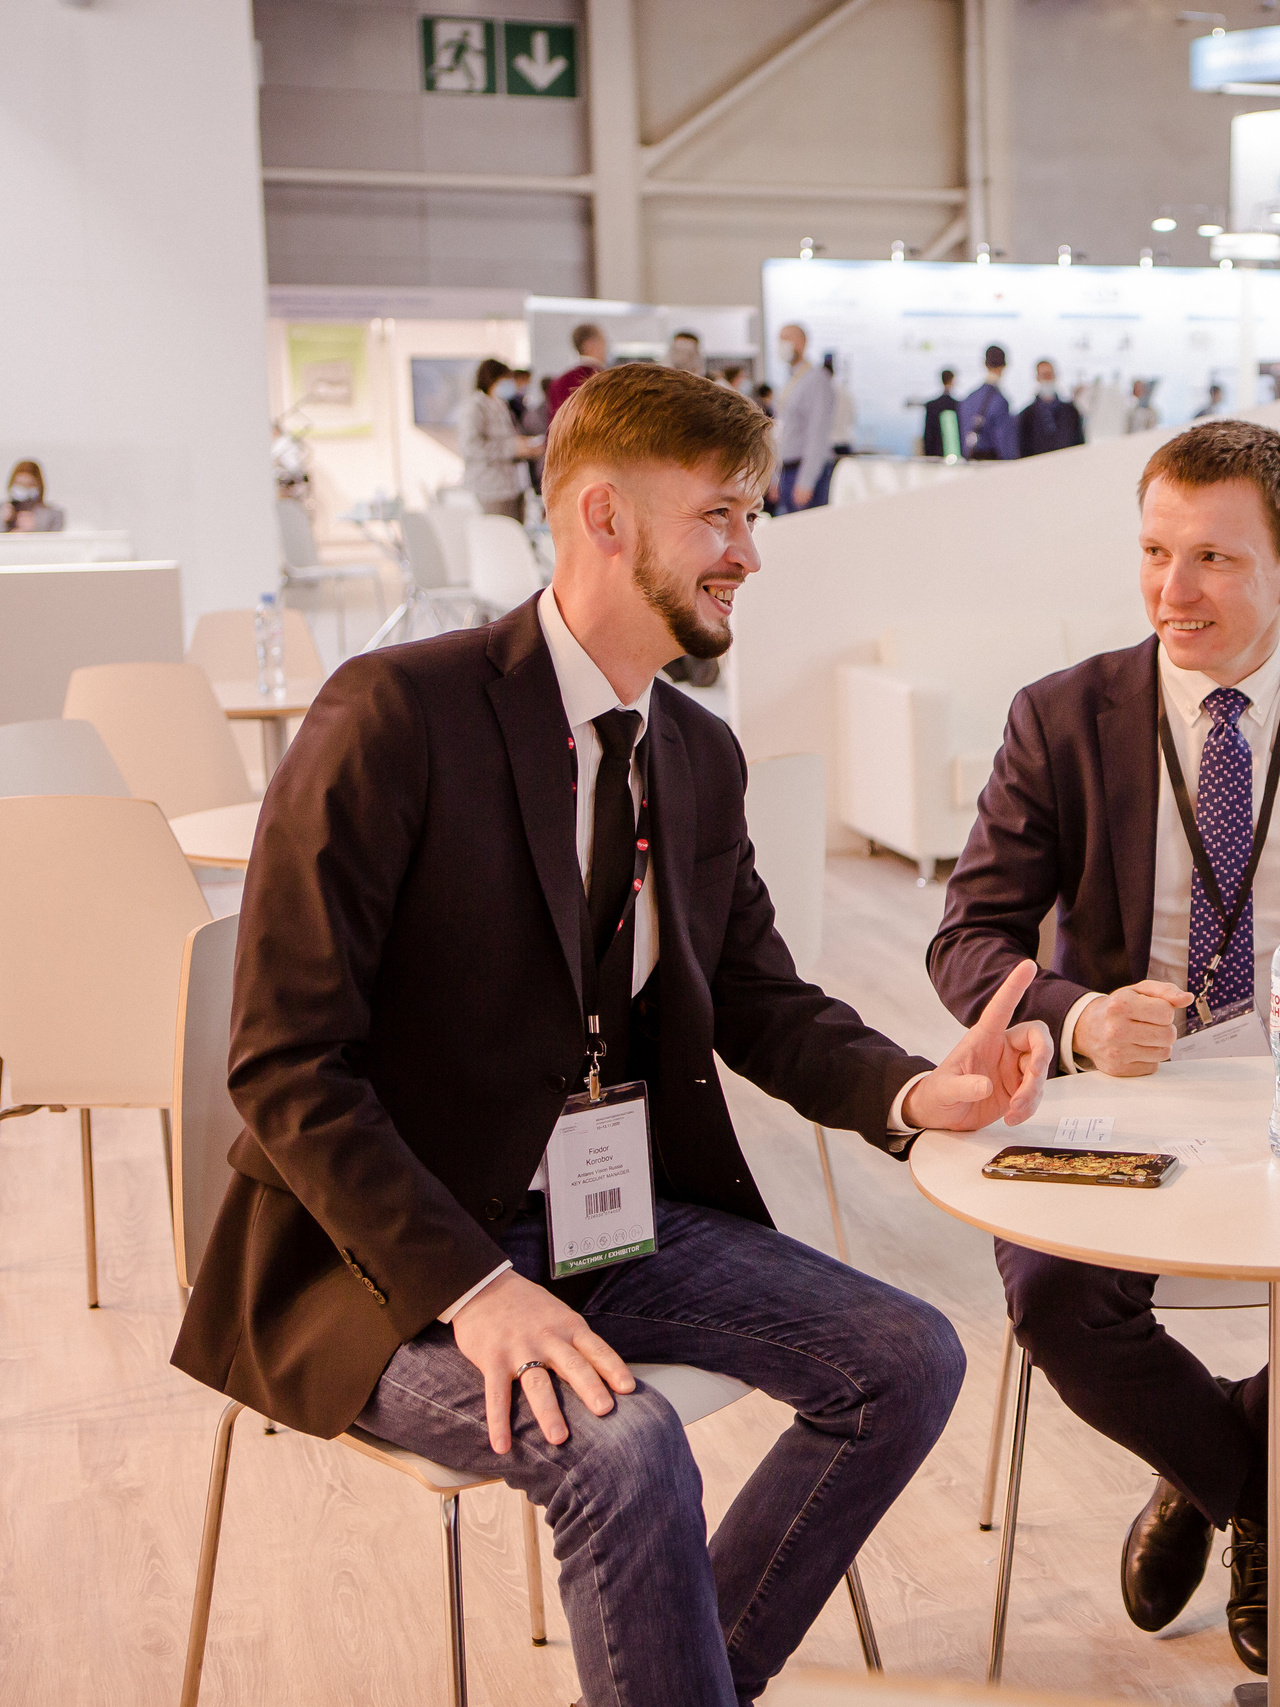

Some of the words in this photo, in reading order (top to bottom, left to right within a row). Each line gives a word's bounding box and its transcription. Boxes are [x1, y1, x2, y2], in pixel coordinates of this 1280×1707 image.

[588, 1145, 610, 1155] Fiodor
[586, 1155, 613, 1166] Korobov
[582, 1175, 605, 1184] ACCOUNT
[606, 1169, 630, 1178] MANAGER
[569, 1254, 603, 1268] УЧАСТНИК
[608, 1245, 640, 1258] EXHIBITOR
